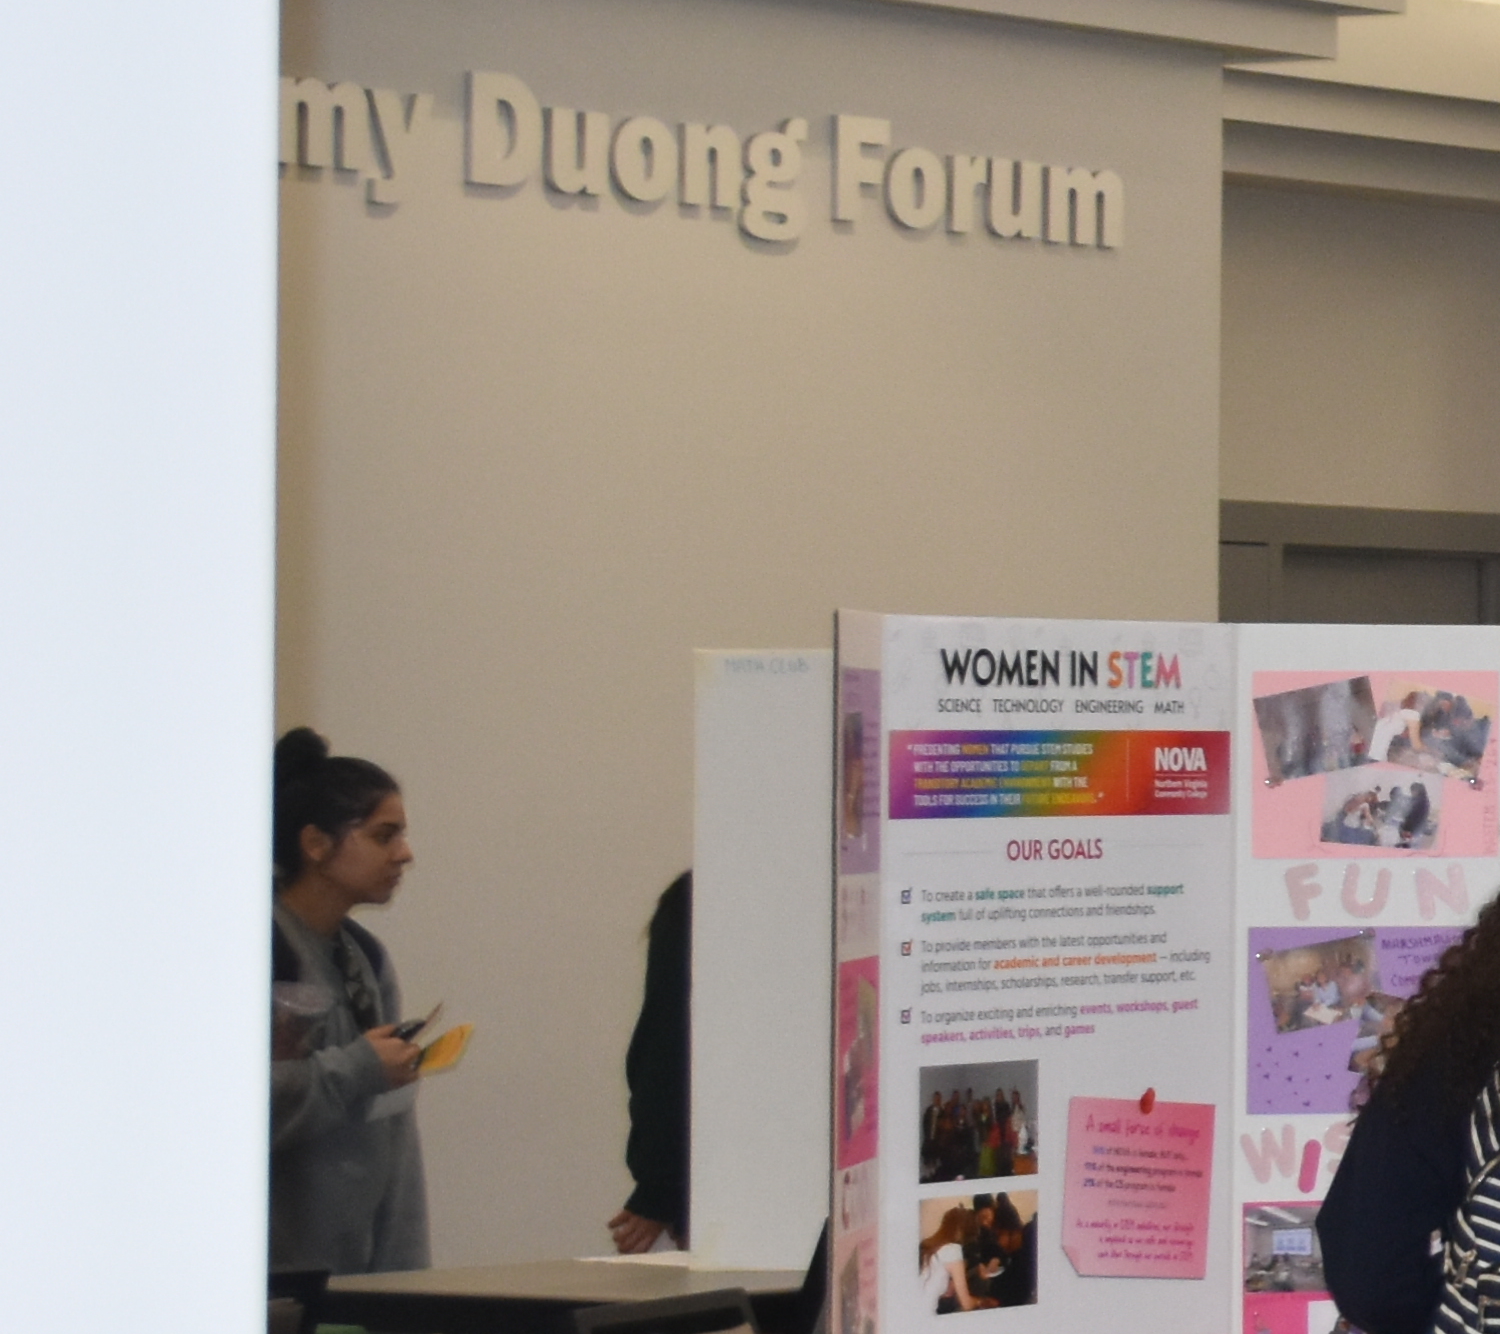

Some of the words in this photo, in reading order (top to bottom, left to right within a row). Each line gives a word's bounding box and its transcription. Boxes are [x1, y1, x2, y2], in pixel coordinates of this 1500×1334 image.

[279, 76, 435, 208] my
[465, 70, 809, 245] Duong
[832, 113, 1124, 248] Forum
[941, 649, 1060, 688] WOMEN
[1071, 650, 1098, 687] IN
[1107, 651, 1182, 688] STEM
[938, 698, 981, 713] SCIENCE
[993, 698, 1064, 714] TECHNOLOGY
[1075, 699, 1144, 714] ENGINEERING
[1154, 699, 1185, 714] MATH
[951, 761, 1006, 773] OPPORTUNITIES
[1155, 747, 1207, 772] NOVA
[956, 794, 987, 805] SUCCESS
[1007, 840, 1043, 861] OUR
[1048, 838, 1103, 860] GOALS
[922, 890, 933, 902] To
[935, 891, 965, 902] create
[967, 892, 974, 901] a
[975, 888, 995, 900] safe
[998, 889, 1024, 901] space
[1027, 887, 1047, 898] that
[1049, 886, 1075, 897] offers
[1076, 888, 1083, 897] a
[1084, 884, 1145, 897] well-rounded
[1147, 883, 1184, 897] support
[1284, 863, 1470, 921] FUN
[921, 910, 957, 924] system
[959, 908, 974, 920] full
[976, 908, 986, 920] of
[988, 907, 1027, 922] uplifting
[1029, 905, 1084, 918] connections
[1086, 904, 1104, 916] and
[922, 940, 933, 953] To
[935, 939, 970, 954] provide
[973, 938, 1016, 951] members
[1018, 937, 1039, 949] with
[1042, 936, 1057, 948] the
[1059, 935, 1085, 947] latest
[1087, 933, 1148, 948] opportunities
[1150, 932, 1167, 944] and
[921, 959, 977, 973] information
[978, 958, 992, 970] for
[994, 956, 1039, 970] academic
[1041, 955, 1060, 967] and
[1062, 955, 1092, 967] career
[1094, 952, 1157, 967] development
[1169, 950, 1211, 964] including
[1103, 972, 1139, 985] transfer
[921, 1011, 932, 1023] To
[934, 1011, 975, 1026] organize
[977, 1007, 1014, 1023] exciting
[1016, 1007, 1034, 1019] and
[1035, 1004, 1077, 1019] enriching
[1171, 998, 1198, 1013] guest
[1045, 1024, 1062, 1037] and
[1064, 1023, 1095, 1038] games
[1240, 1121, 1356, 1194] WIS
